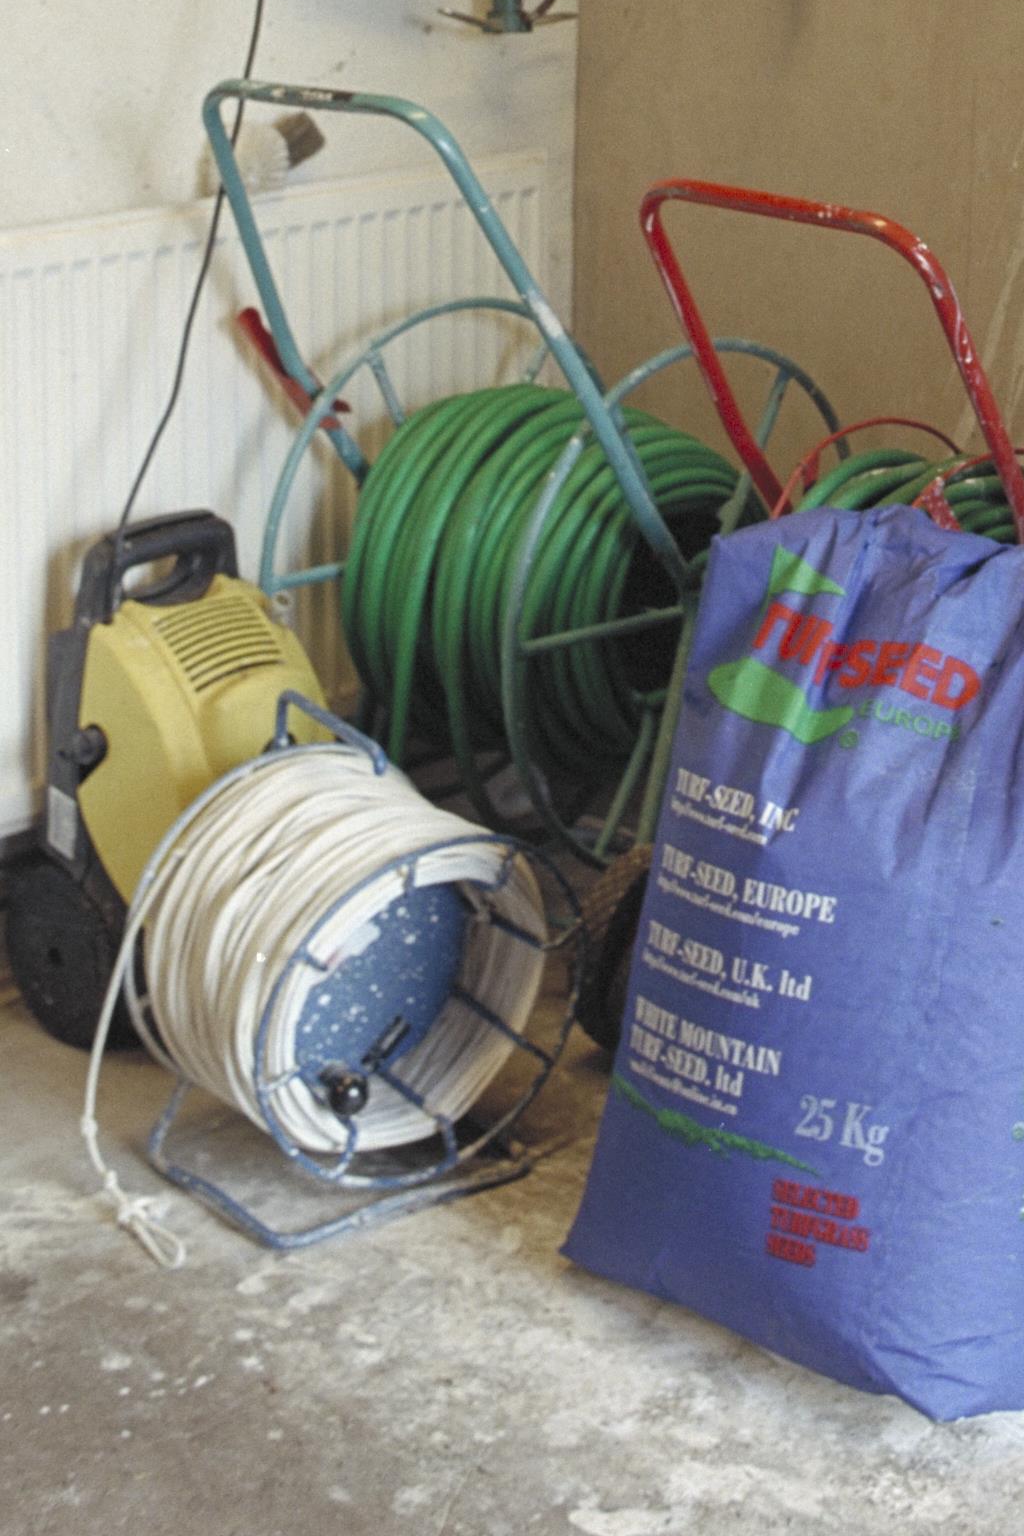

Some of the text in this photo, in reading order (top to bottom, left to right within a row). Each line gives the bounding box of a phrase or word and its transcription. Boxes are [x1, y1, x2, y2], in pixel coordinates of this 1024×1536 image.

[742, 877, 838, 925] EUROPE
[731, 956, 774, 993] U.K.
[777, 968, 813, 1002] ltd
[635, 993, 782, 1077] WHITE MOUNTAIN
[714, 1064, 745, 1099] ltd
[794, 1093, 890, 1167] 25 Kg
[771, 1177, 861, 1221] SELECTED
[764, 1231, 817, 1269] SEEDS
[769, 1204, 871, 1254] TURFGRASS
